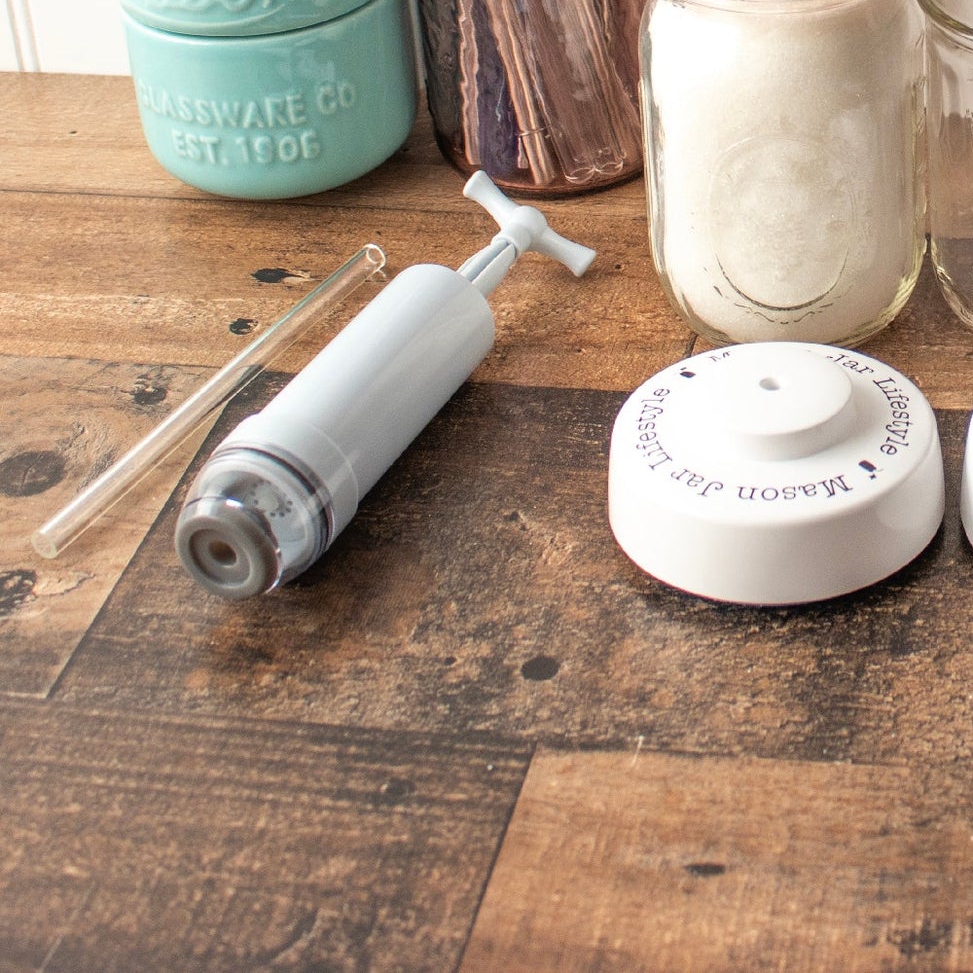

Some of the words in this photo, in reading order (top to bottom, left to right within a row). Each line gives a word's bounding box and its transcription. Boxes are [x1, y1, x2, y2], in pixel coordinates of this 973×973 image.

[138, 79, 307, 128] GLASSWARE
[316, 81, 357, 116] CO
[172, 128, 229, 166] EST.
[636, 388, 673, 470] Lifestyle
[873, 377, 913, 455] Lifestyle
[670, 468, 723, 497] Jar
[738, 475, 853, 501] Mason
